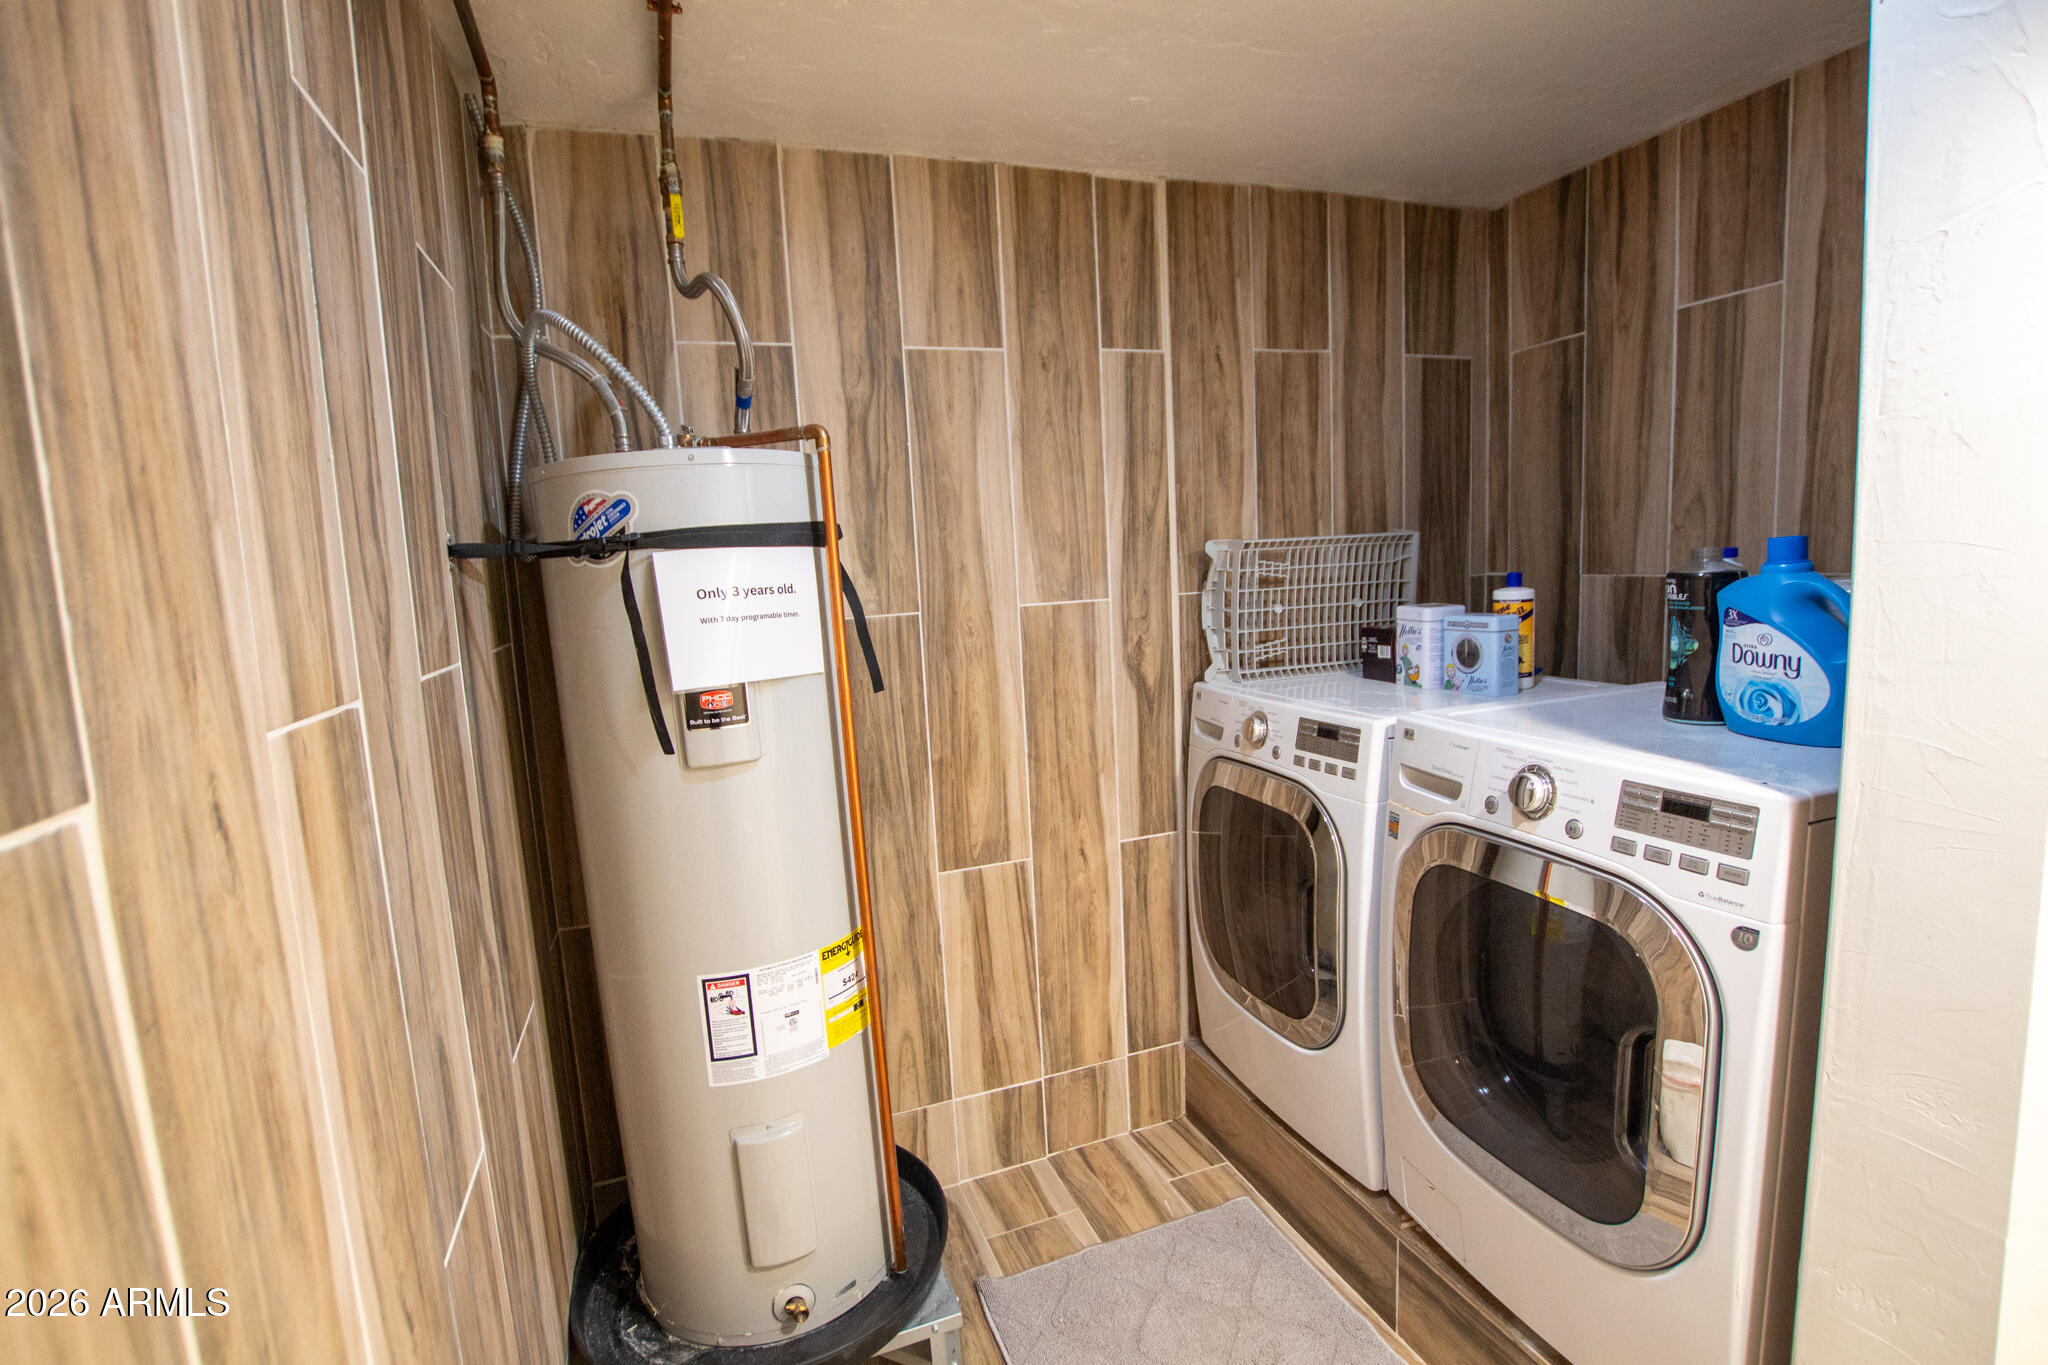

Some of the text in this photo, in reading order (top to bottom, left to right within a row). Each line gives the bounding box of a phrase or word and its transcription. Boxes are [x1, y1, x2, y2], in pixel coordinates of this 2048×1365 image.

[696, 583, 797, 601] Only 3 years old.
[699, 616, 719, 625] With
[726, 615, 740, 624] day
[1728, 608, 1738, 620] 3X
[1732, 642, 1802, 680] Downy
